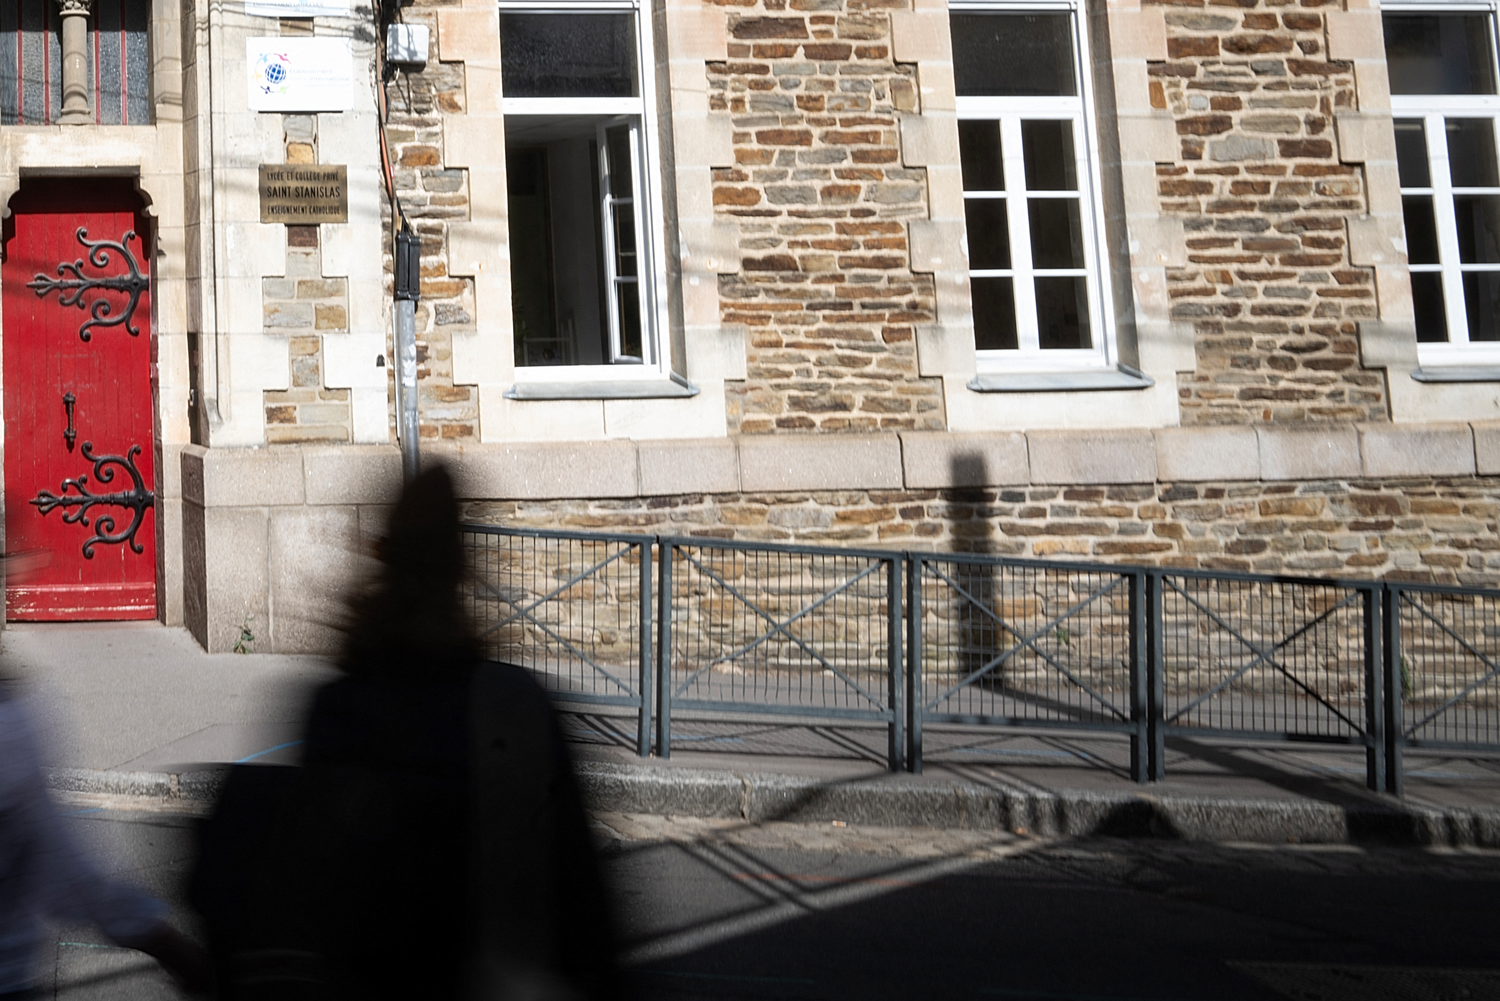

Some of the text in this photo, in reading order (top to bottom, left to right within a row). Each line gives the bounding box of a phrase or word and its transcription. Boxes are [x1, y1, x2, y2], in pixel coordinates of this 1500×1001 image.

[267, 170, 284, 181] LYCÉE
[287, 172, 293, 181] ET
[322, 170, 339, 181] PRIVÉ
[267, 186, 340, 198] SAINT STANISLAS
[267, 205, 340, 215] ENSEIGNEMENT CATHOLIQUE
